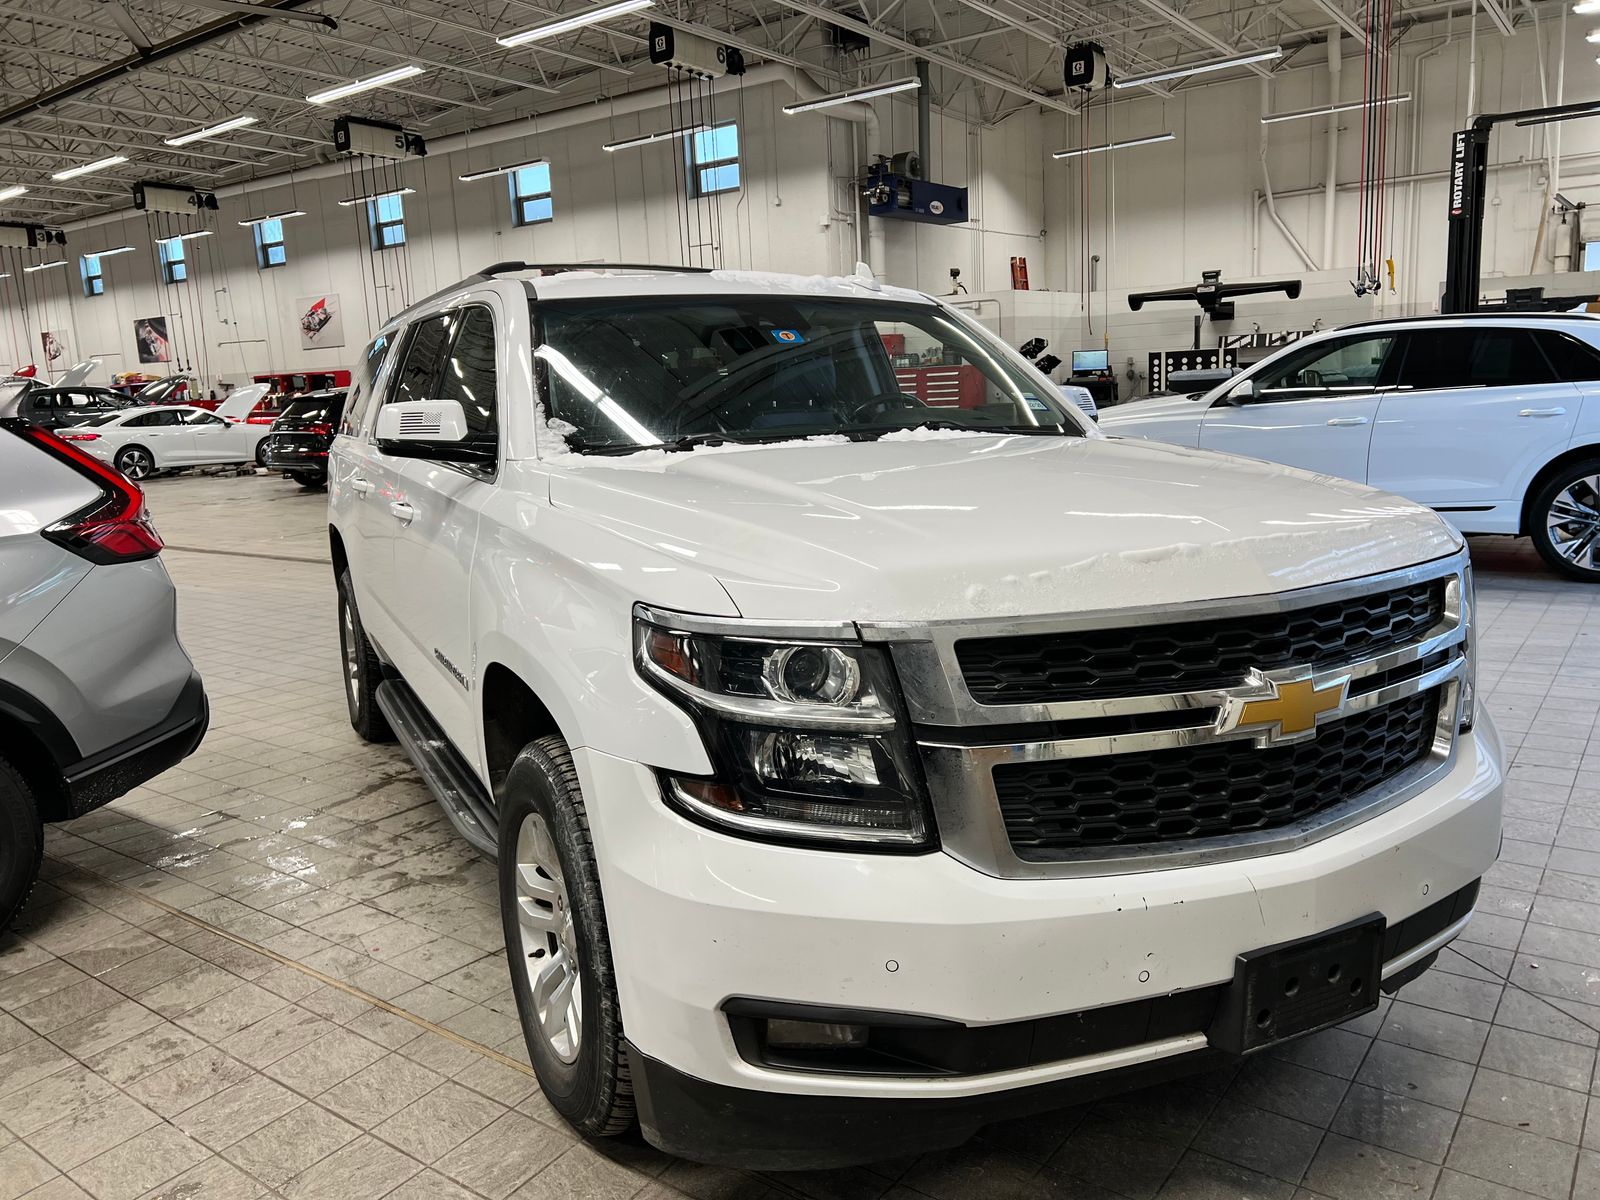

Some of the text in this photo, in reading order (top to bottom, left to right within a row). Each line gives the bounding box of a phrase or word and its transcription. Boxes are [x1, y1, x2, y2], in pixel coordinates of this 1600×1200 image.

[717, 46, 726, 64] 6
[394, 135, 405, 149] 5
[1453, 133, 1466, 208] ROTARY LIFT
[187, 195, 197, 207] 4
[37, 232, 46, 242] 3
